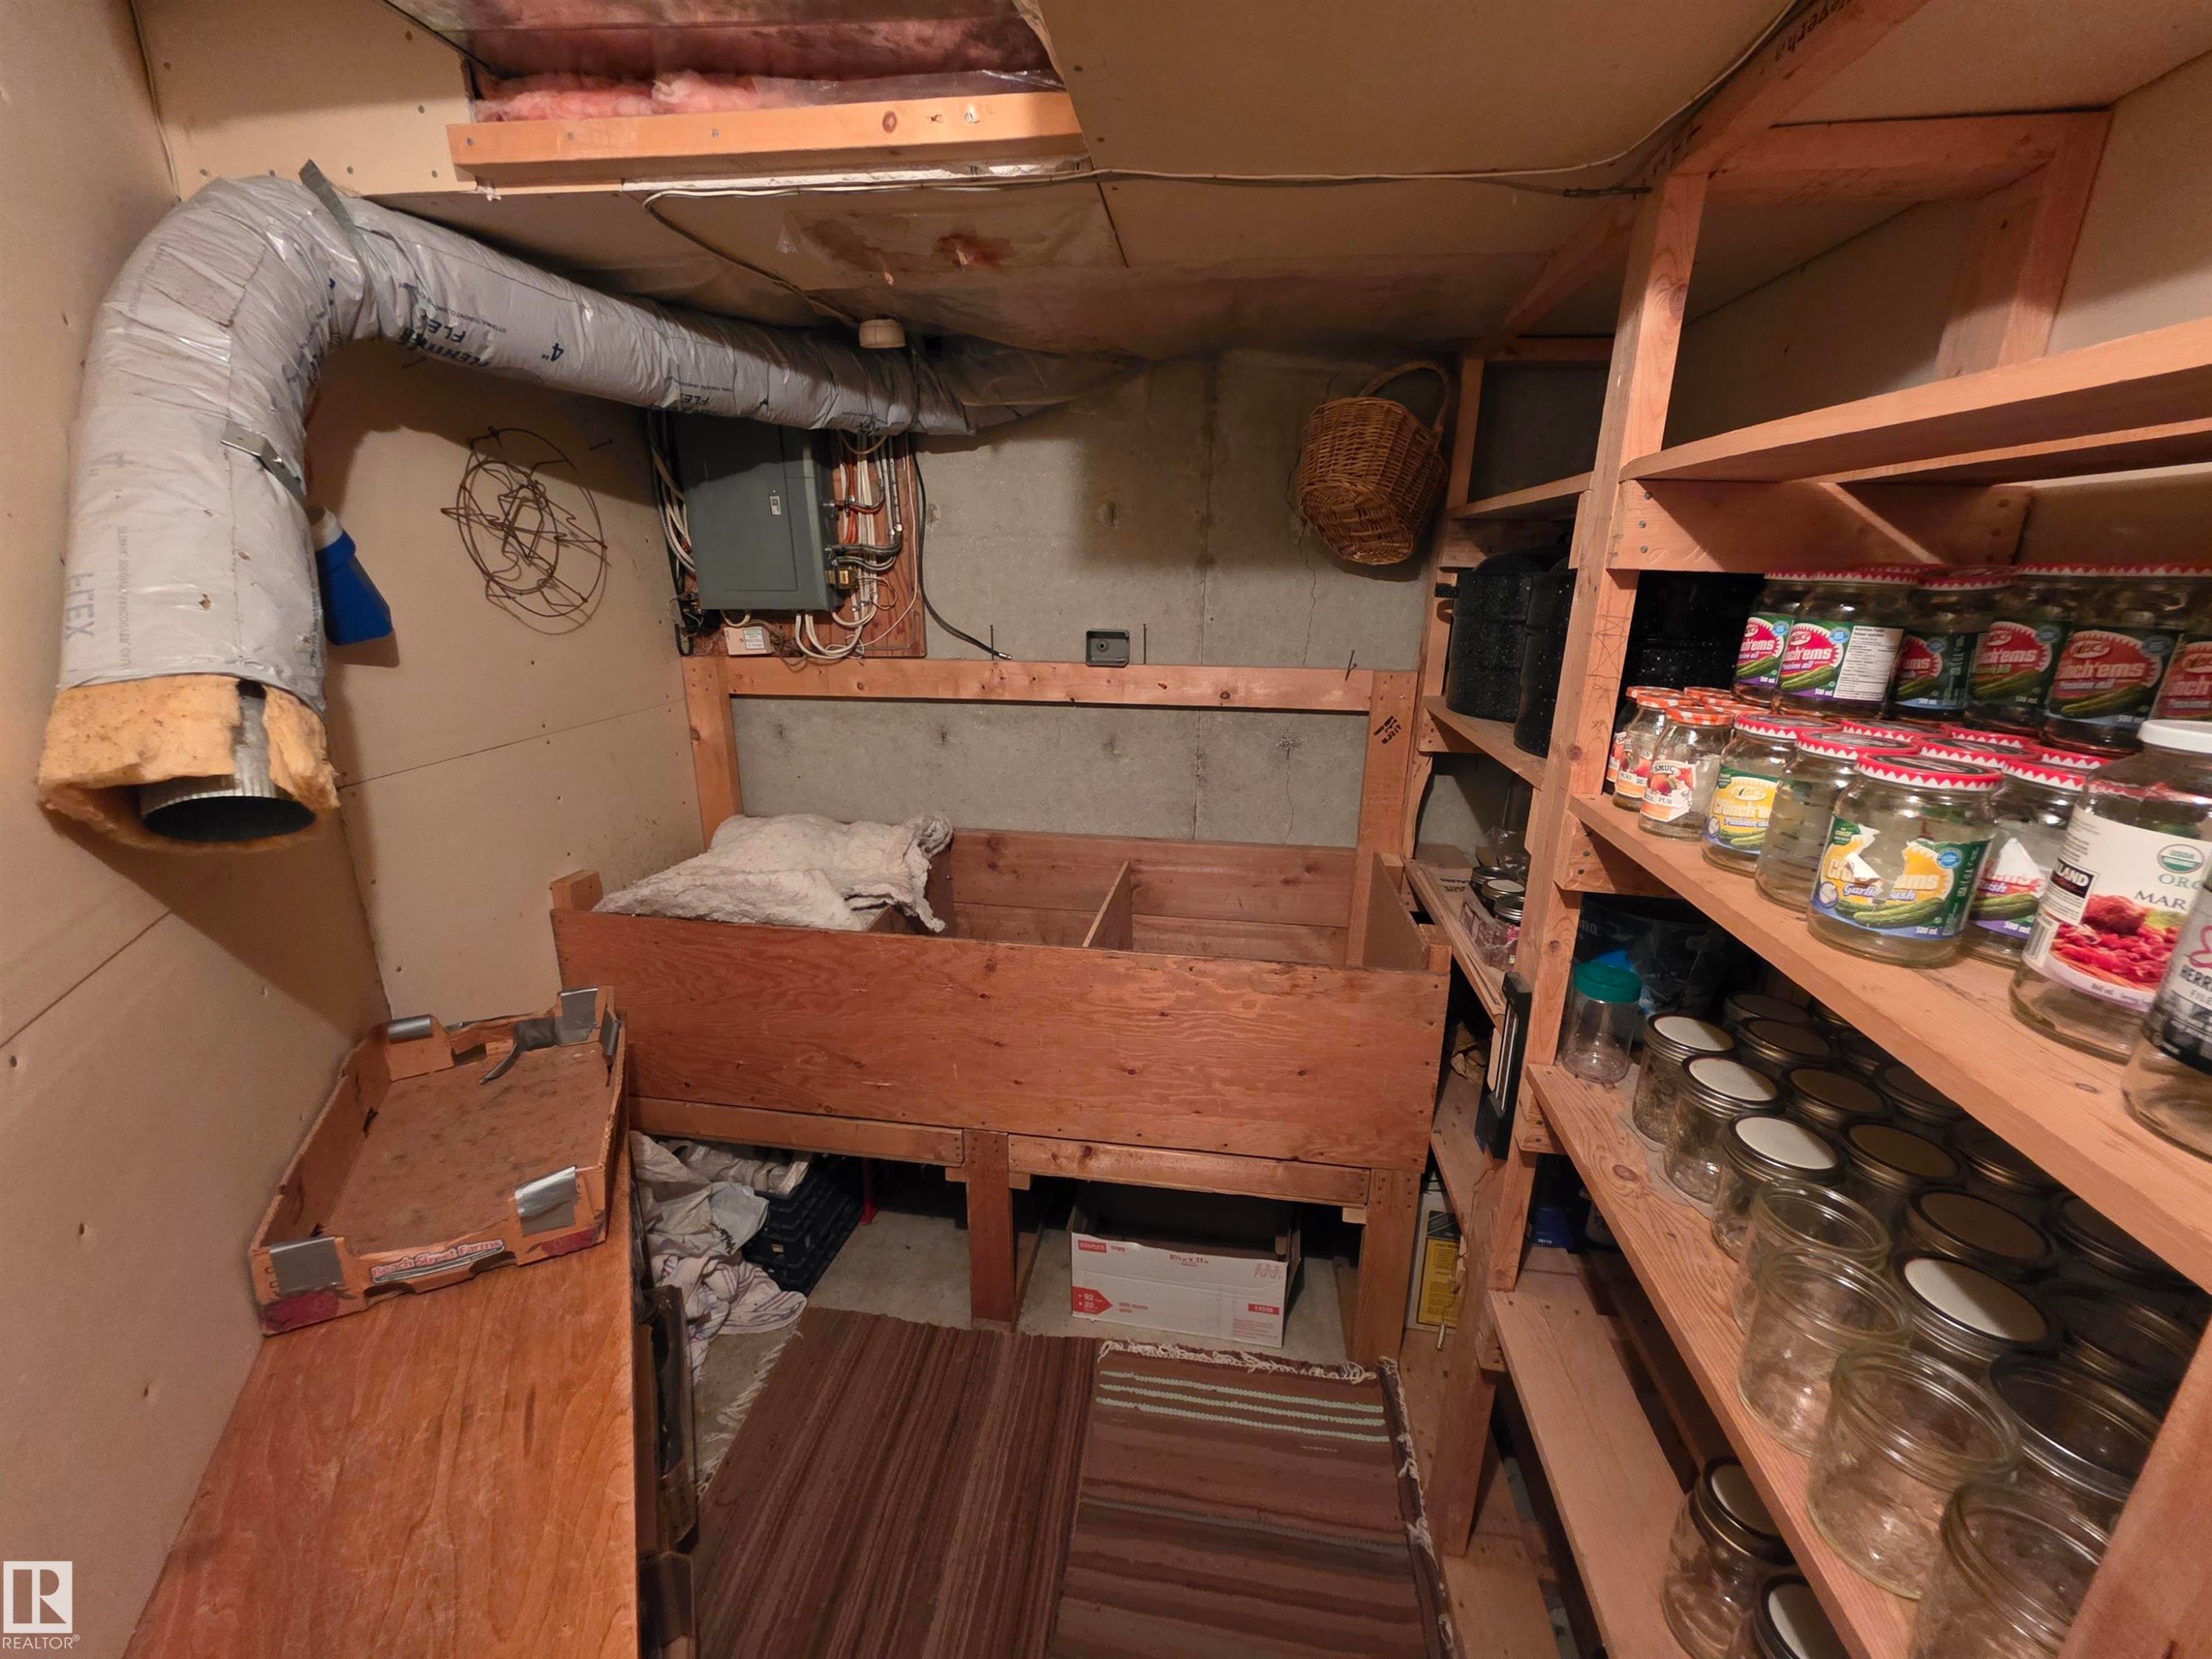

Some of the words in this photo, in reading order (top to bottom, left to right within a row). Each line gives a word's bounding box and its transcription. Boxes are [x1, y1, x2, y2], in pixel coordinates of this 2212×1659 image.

[425, 317, 466, 344] FLE
[679, 392, 711, 406] FLE
[2134, 890, 2188, 911] MAR
[1079, 1241, 1106, 1252] STAPLES
[372, 1258, 414, 1276] Beach
[416, 1248, 457, 1267] Street
[459, 1240, 502, 1256] Farms
